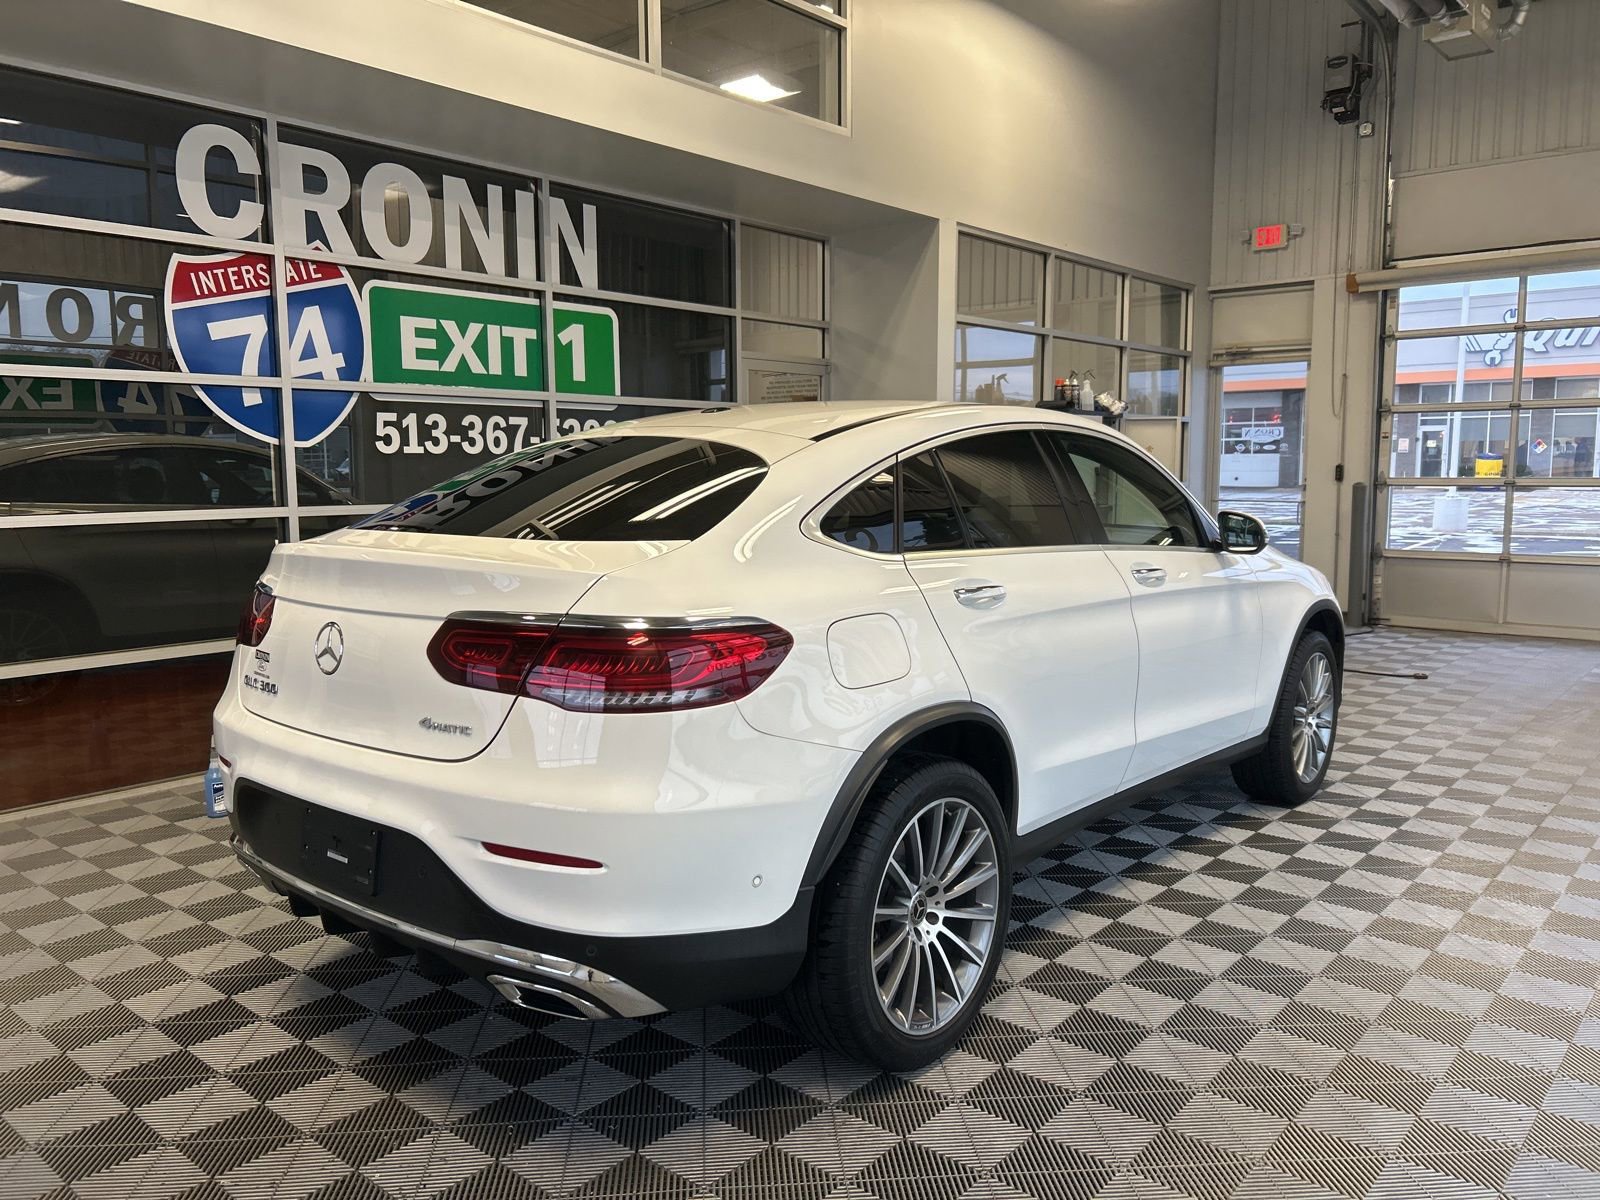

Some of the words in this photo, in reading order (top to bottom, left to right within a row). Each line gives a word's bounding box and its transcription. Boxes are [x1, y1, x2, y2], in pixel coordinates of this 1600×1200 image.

[175, 123, 599, 290] CRONIN
[190, 260, 322, 296] INTERSATE
[207, 305, 346, 408] 74
[400, 315, 537, 377] EXIT
[557, 323, 586, 382] 1
[375, 411, 617, 455] 513-367-
[244, 674, 259, 690] GLC
[260, 680, 279, 695] 300
[419, 716, 473, 737] 4MATIC
